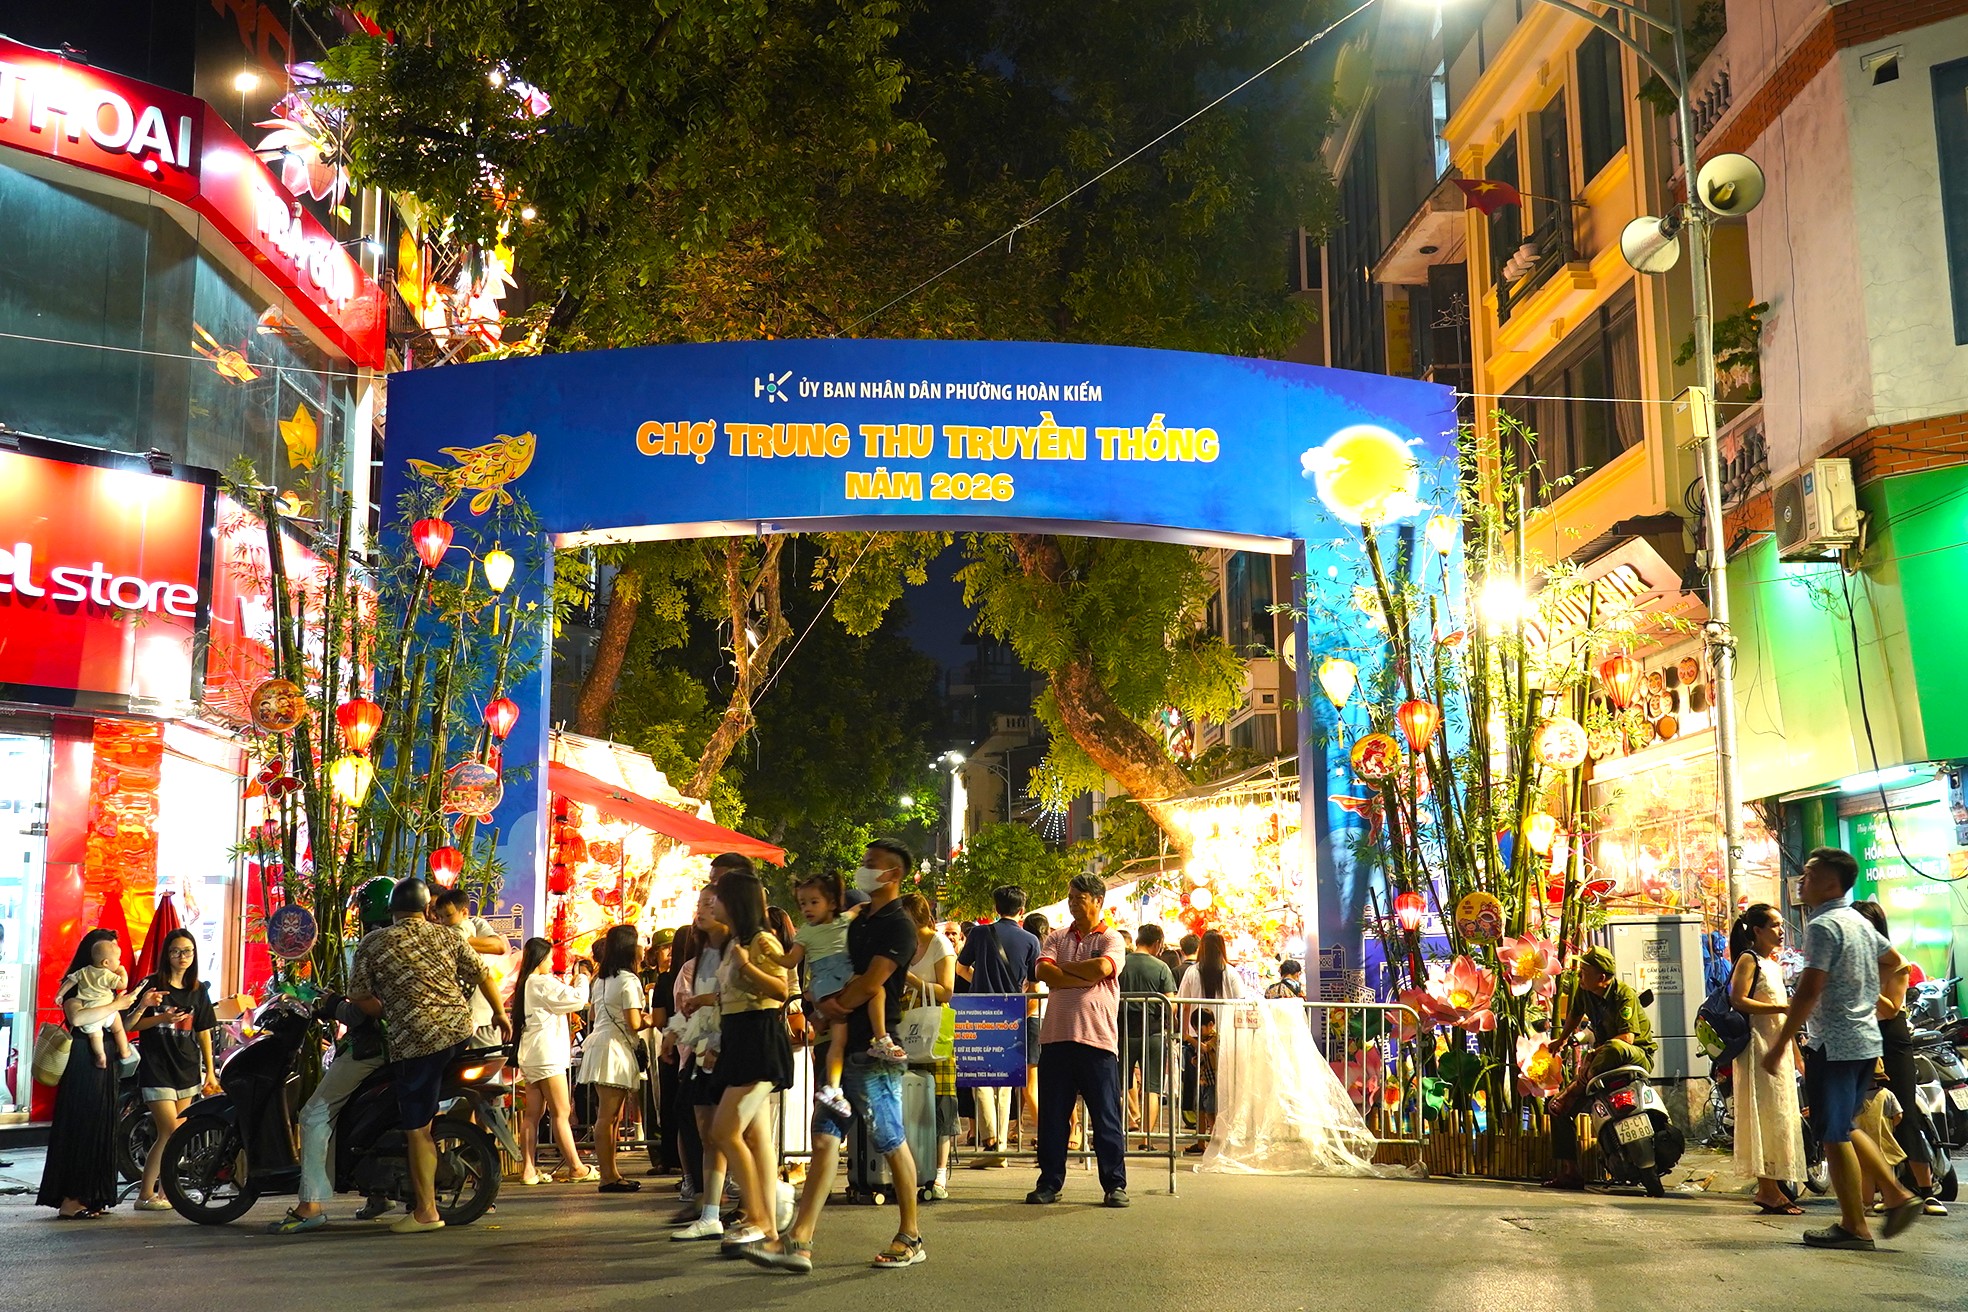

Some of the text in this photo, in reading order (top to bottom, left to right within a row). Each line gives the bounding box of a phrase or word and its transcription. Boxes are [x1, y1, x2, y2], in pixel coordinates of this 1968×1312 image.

[800, 377, 1102, 402] ỦY BAN NHÂN DÂN PHƯỜNG HOÀN KIẾM
[636, 411, 1220, 464] CHỢ TRUNG THU TRUYỀN THỐNG
[845, 466, 1015, 501] NĂM 2026
[51, 562, 199, 617] store
